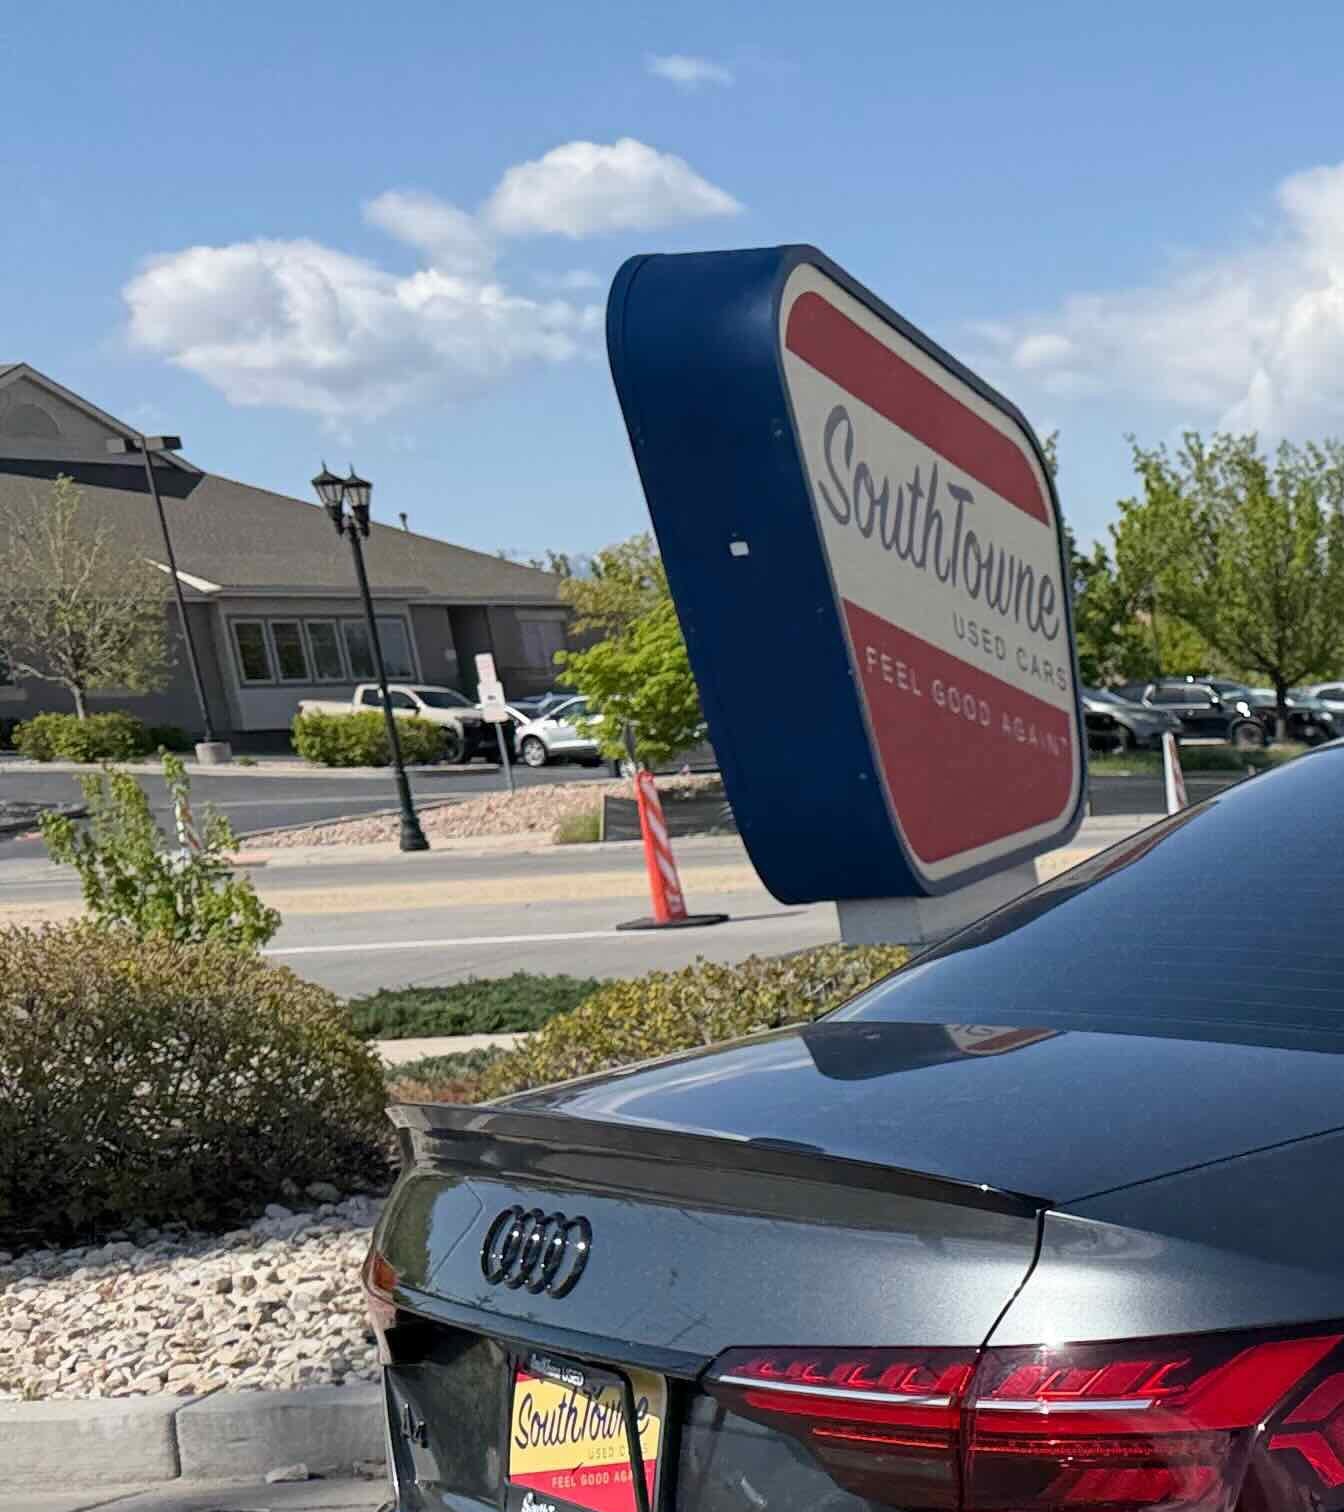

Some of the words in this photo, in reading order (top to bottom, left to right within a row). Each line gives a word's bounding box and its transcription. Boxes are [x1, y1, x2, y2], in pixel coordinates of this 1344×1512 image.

[818, 405, 1060, 641] SouthTowne
[865, 645, 922, 697] FEEL
[932, 679, 991, 727] GOOD
[953, 612, 1006, 660] USED
[1016, 648, 1067, 691] CARS
[552, 1476, 577, 1489] FEEL
[581, 1473, 610, 1487] GOOD
